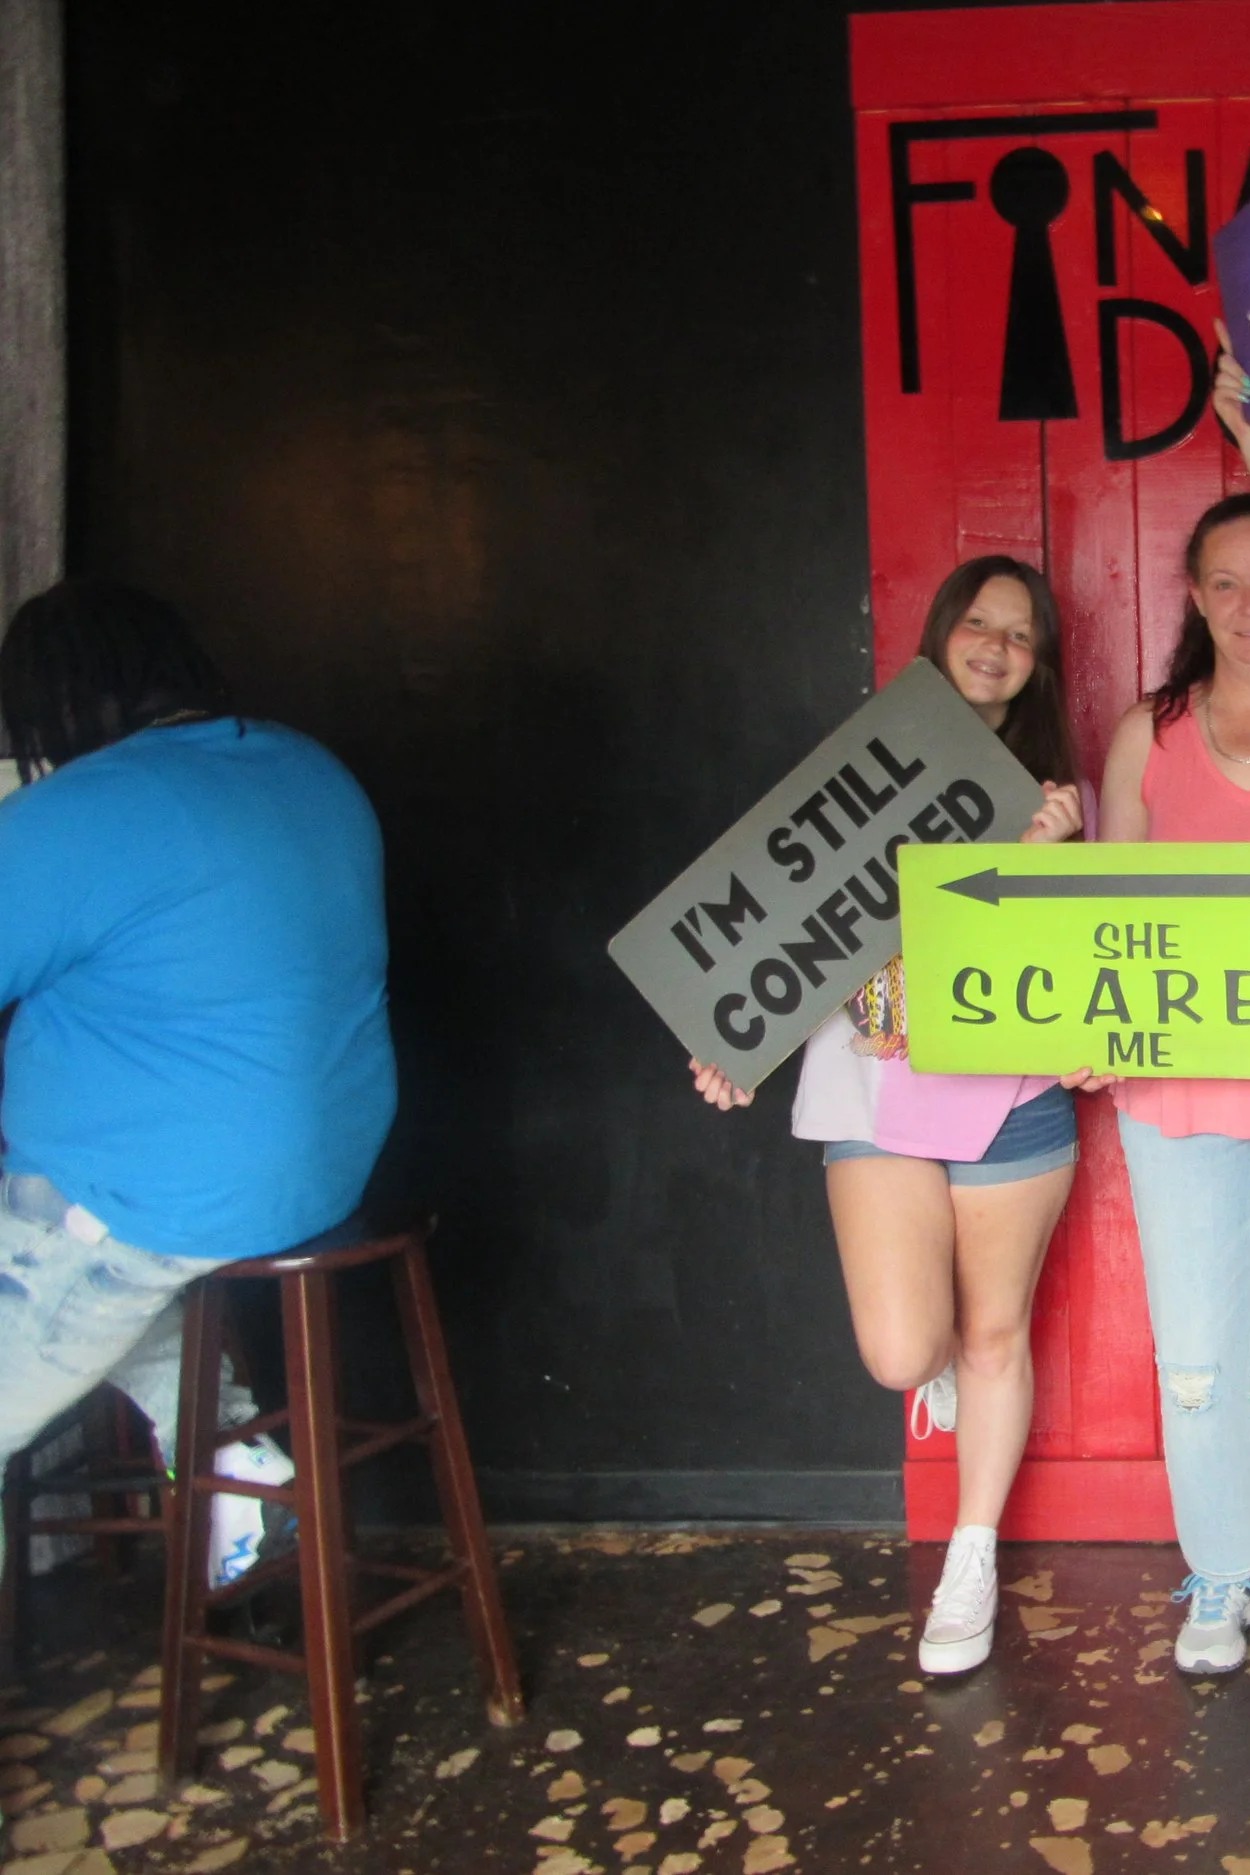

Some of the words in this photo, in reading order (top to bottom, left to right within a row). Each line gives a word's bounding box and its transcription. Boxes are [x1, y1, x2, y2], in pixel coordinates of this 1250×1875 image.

[670, 871, 768, 973] I'M
[766, 737, 927, 884] STILL
[1093, 922, 1181, 961] SHE
[1107, 1031, 1174, 1068] ME
